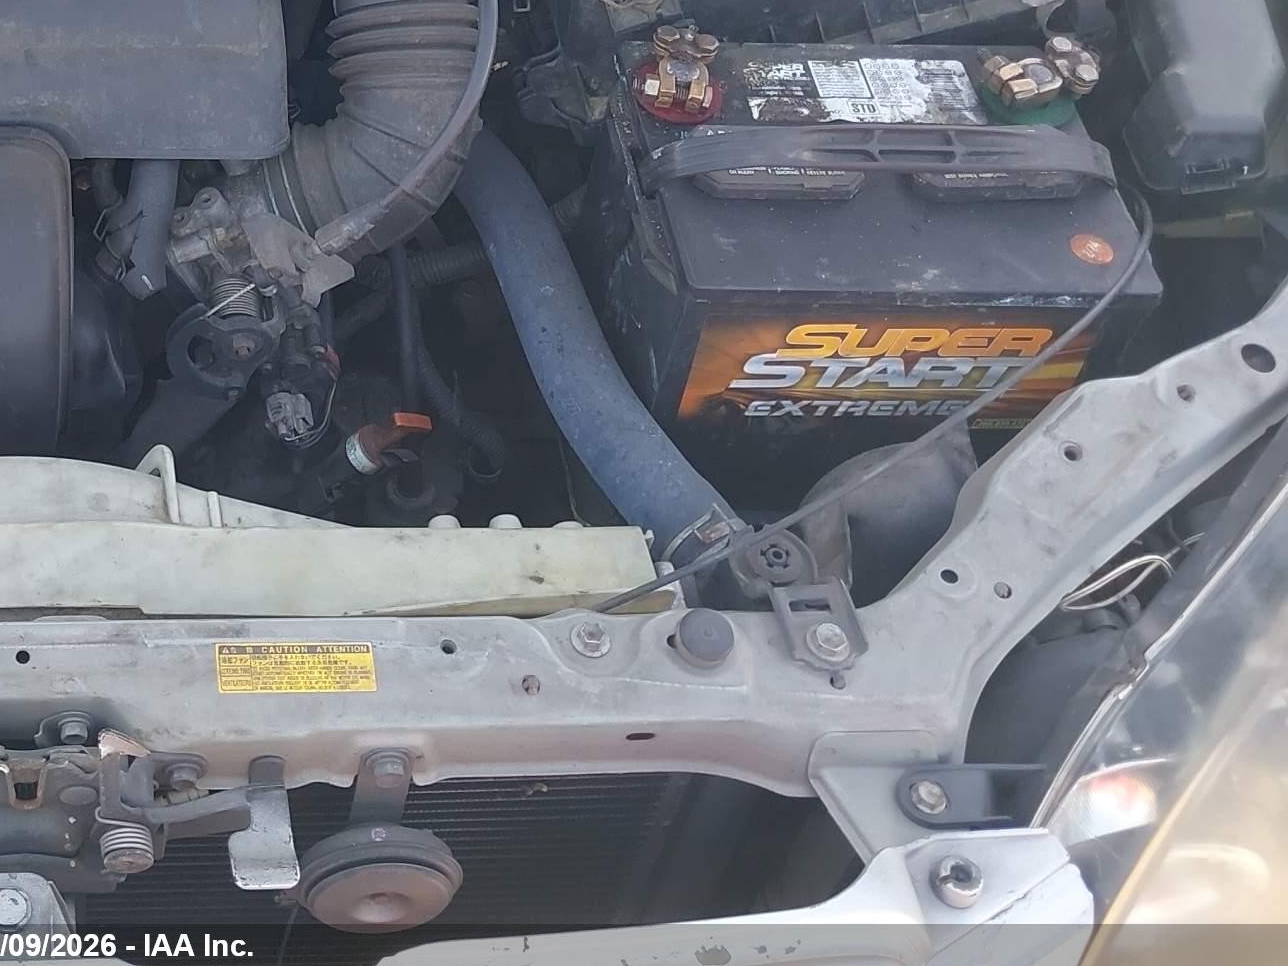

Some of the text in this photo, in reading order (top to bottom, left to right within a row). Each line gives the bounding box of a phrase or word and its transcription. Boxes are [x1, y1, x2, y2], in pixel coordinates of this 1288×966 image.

[852, 103, 876, 114] STD
[776, 323, 1053, 357] SUPER
[728, 353, 1032, 388] START
[261, 645, 308, 654] CAUTION
[316, 644, 368, 653] ATTENTION
